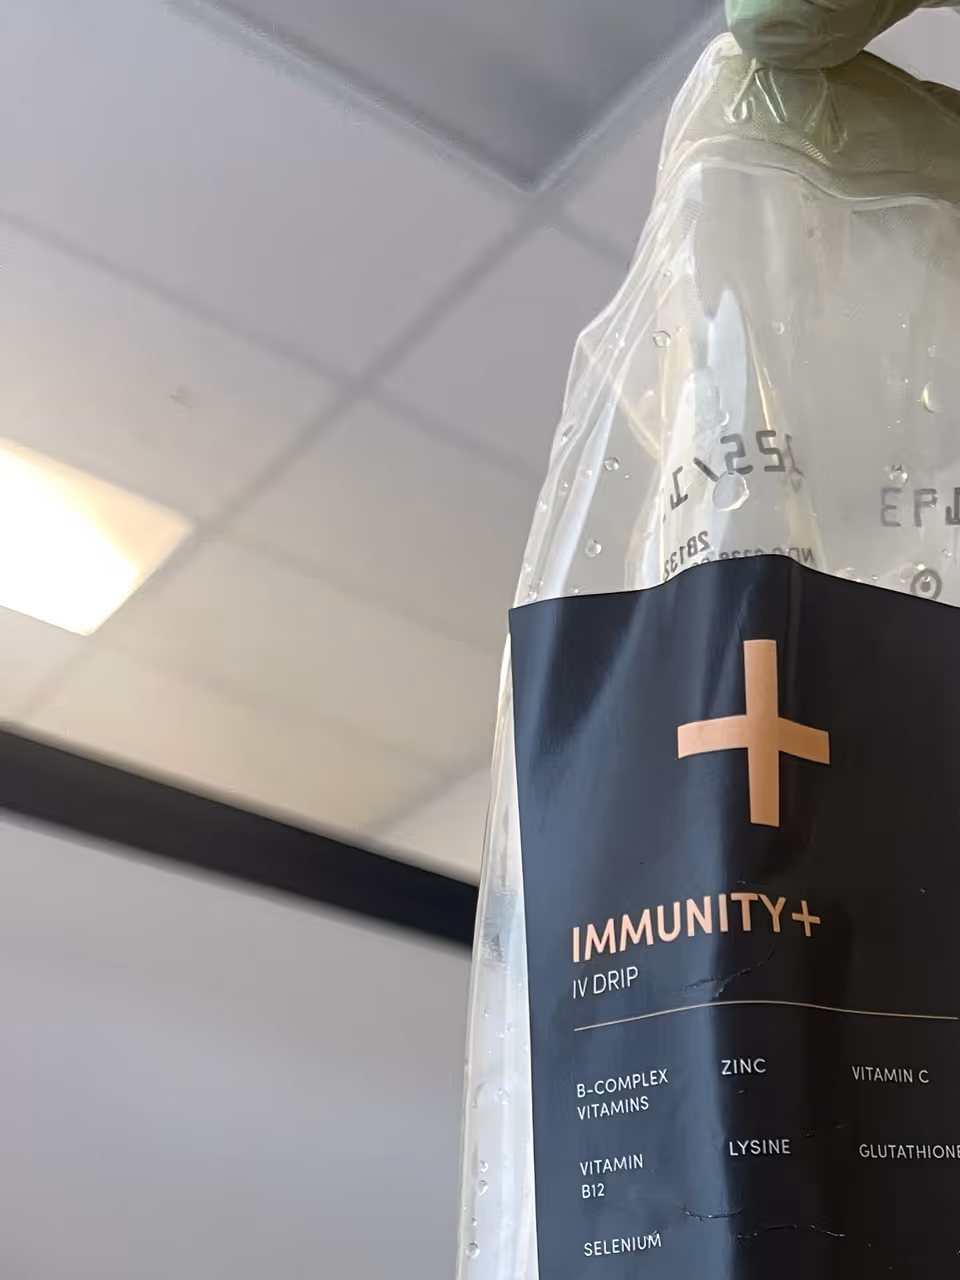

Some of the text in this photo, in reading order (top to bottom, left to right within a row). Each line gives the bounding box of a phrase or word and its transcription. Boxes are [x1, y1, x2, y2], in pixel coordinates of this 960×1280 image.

[572, 892, 821, 963] IMMUNITY+
[572, 966, 639, 999] IV DRIP
[721, 1057, 767, 1076] ZINC
[851, 1065, 930, 1084] VITAMIN C
[576, 1068, 669, 1098] B-COMPLEX
[576, 1095, 650, 1120] VITAMINS
[729, 1139, 792, 1156] LYSINE
[579, 1153, 644, 1176] VITAMIN
[581, 1183, 605, 1199] B12
[583, 1233, 662, 1257] SELENIUM
